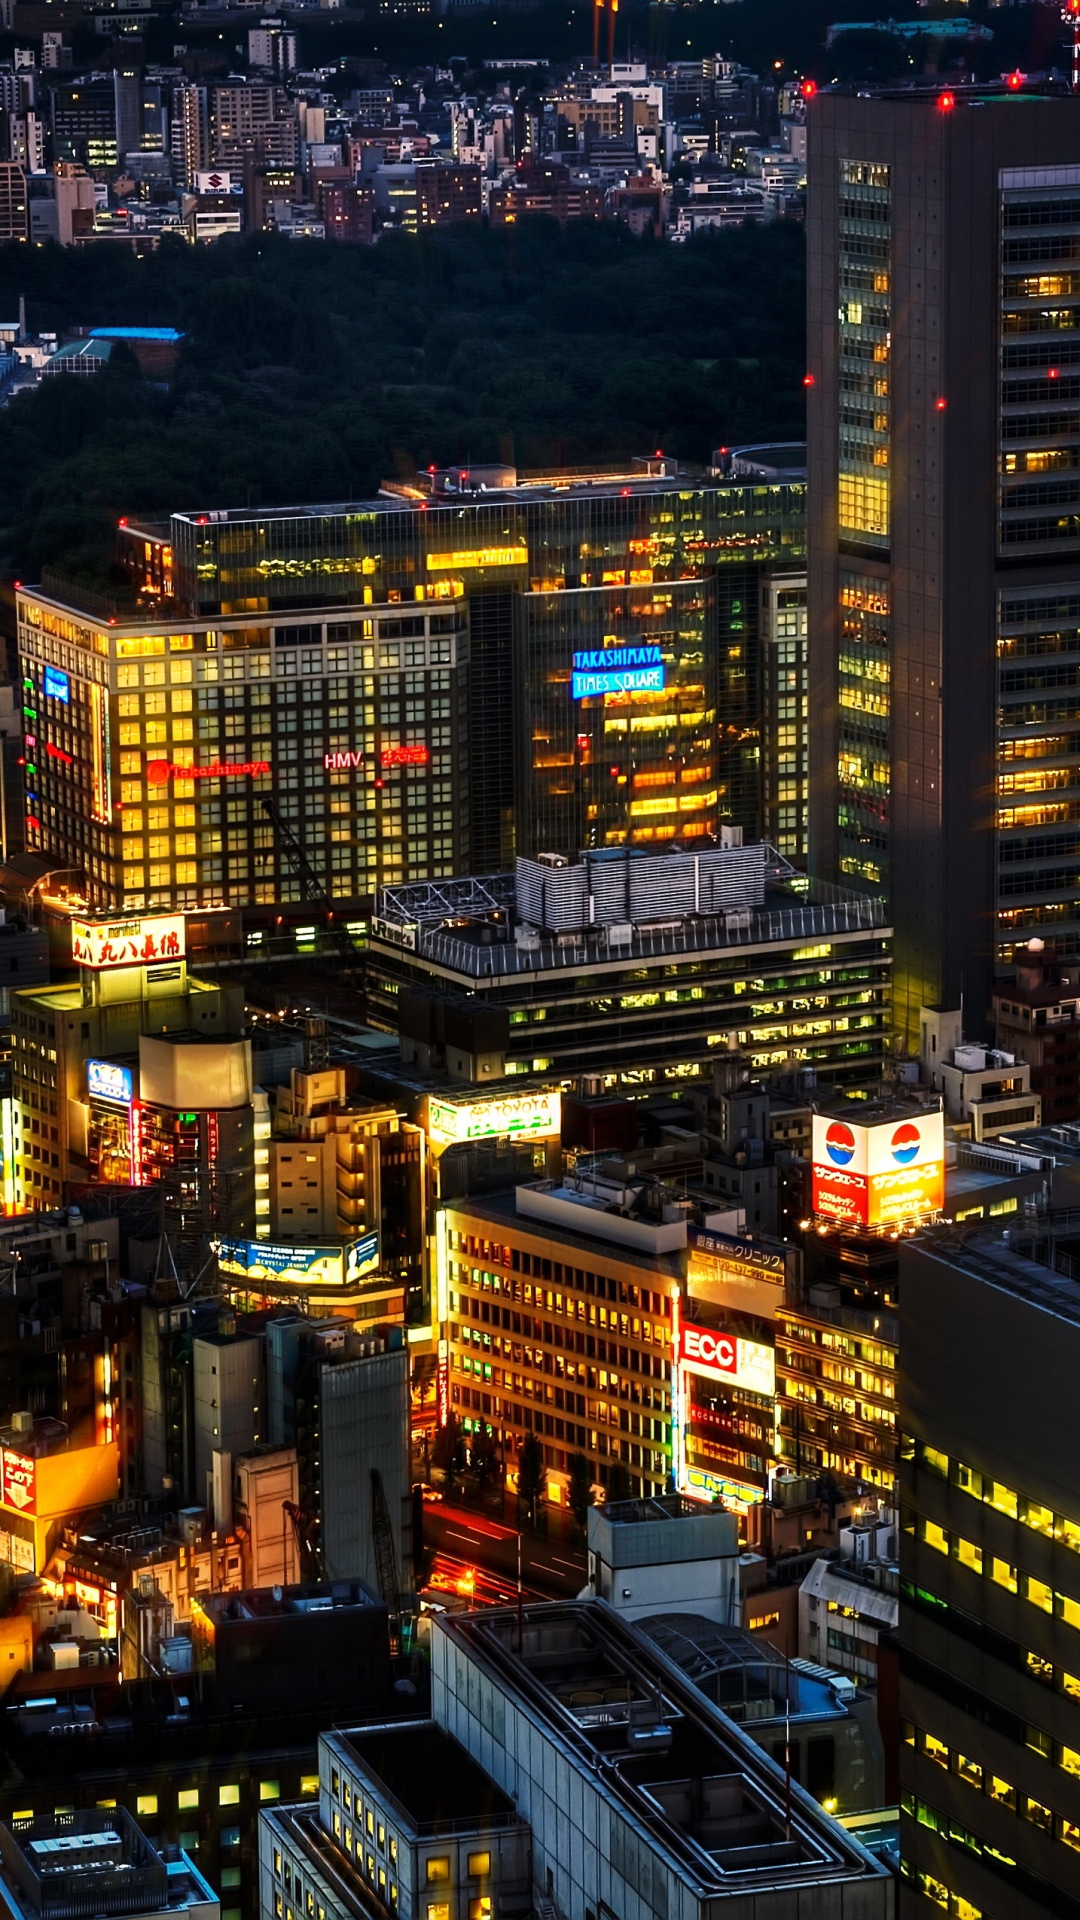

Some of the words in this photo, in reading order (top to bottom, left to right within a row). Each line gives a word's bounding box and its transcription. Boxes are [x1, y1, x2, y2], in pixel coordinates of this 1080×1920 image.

[574, 647, 661, 669] TAKASHIMAYA
[576, 675, 609, 692] TIMES
[614, 671, 660, 698] SQUARE
[170, 757, 270, 779] Takashimaya
[494, 1099, 550, 1117] TOYOTA
[684, 1329, 734, 1367] ECC
